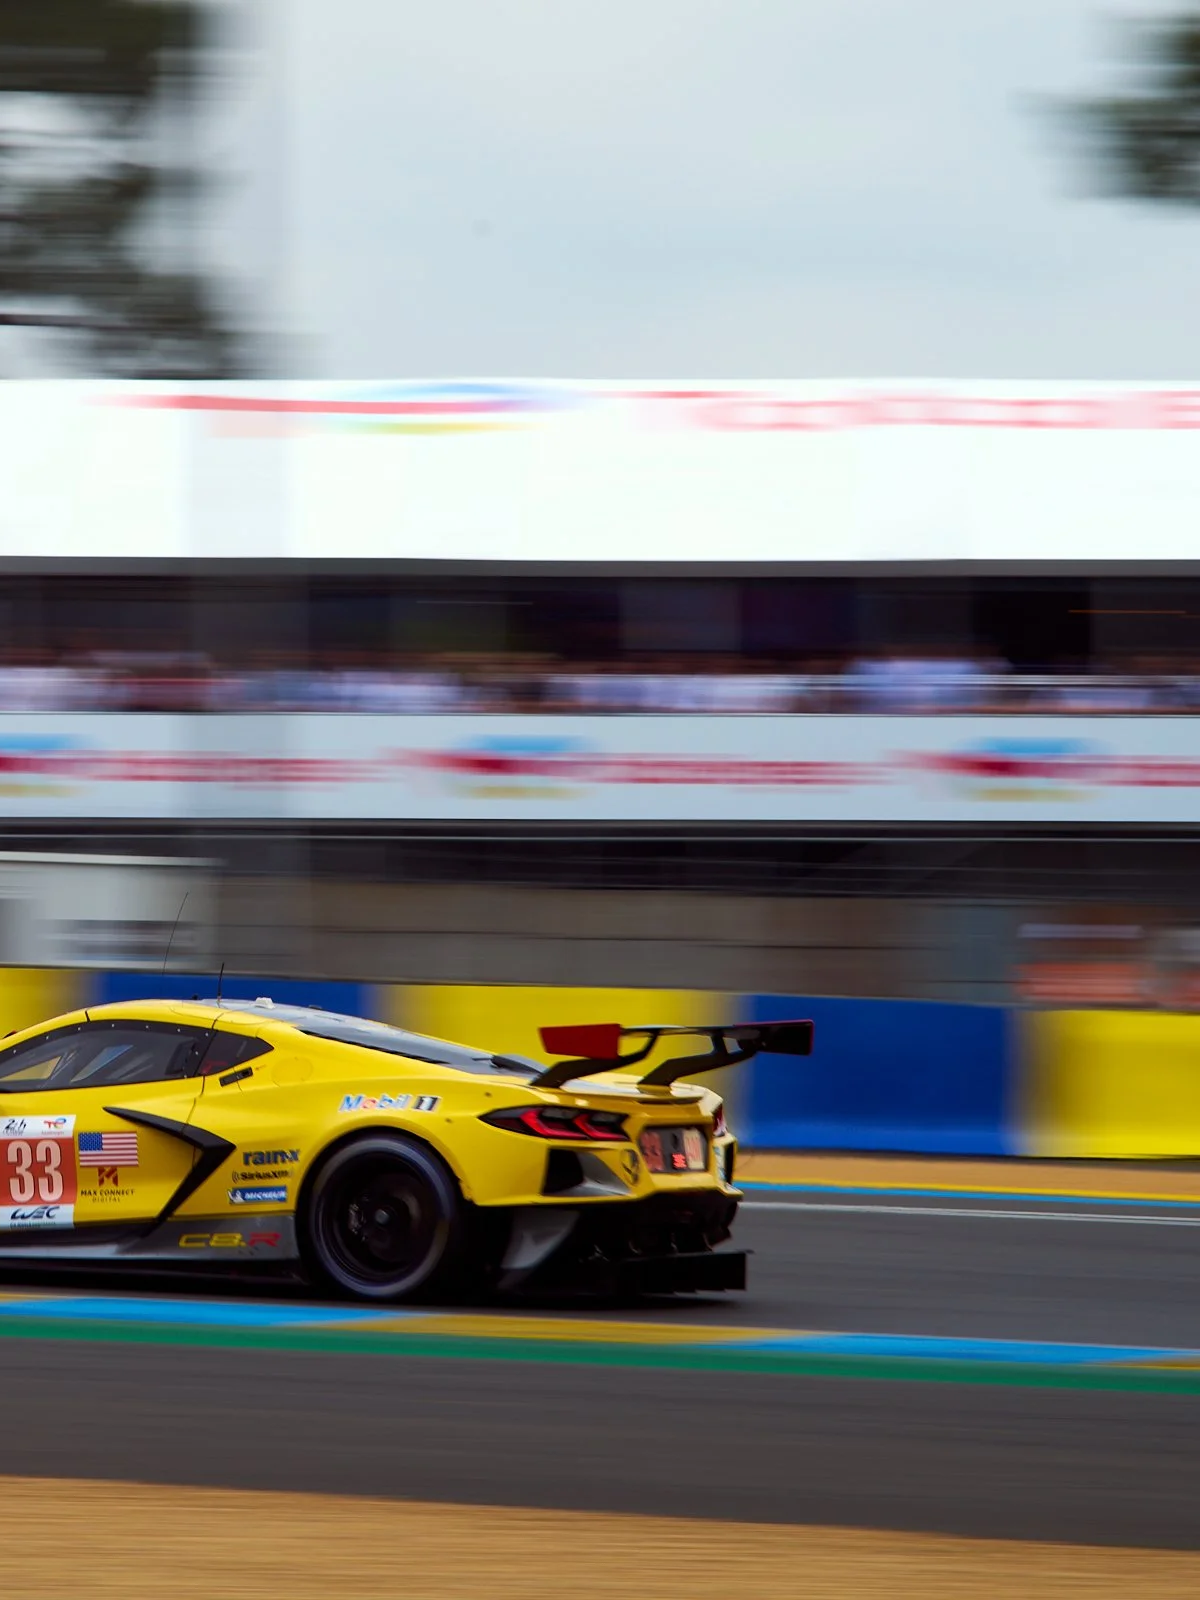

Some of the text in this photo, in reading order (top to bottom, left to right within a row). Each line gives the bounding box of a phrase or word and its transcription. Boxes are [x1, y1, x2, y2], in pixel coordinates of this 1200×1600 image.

[340, 1093, 413, 1112] Mobil
[7, 1139, 64, 1203] 33
[99, 1188, 135, 1196] CONNECT
[10, 1205, 60, 1220] WEC
